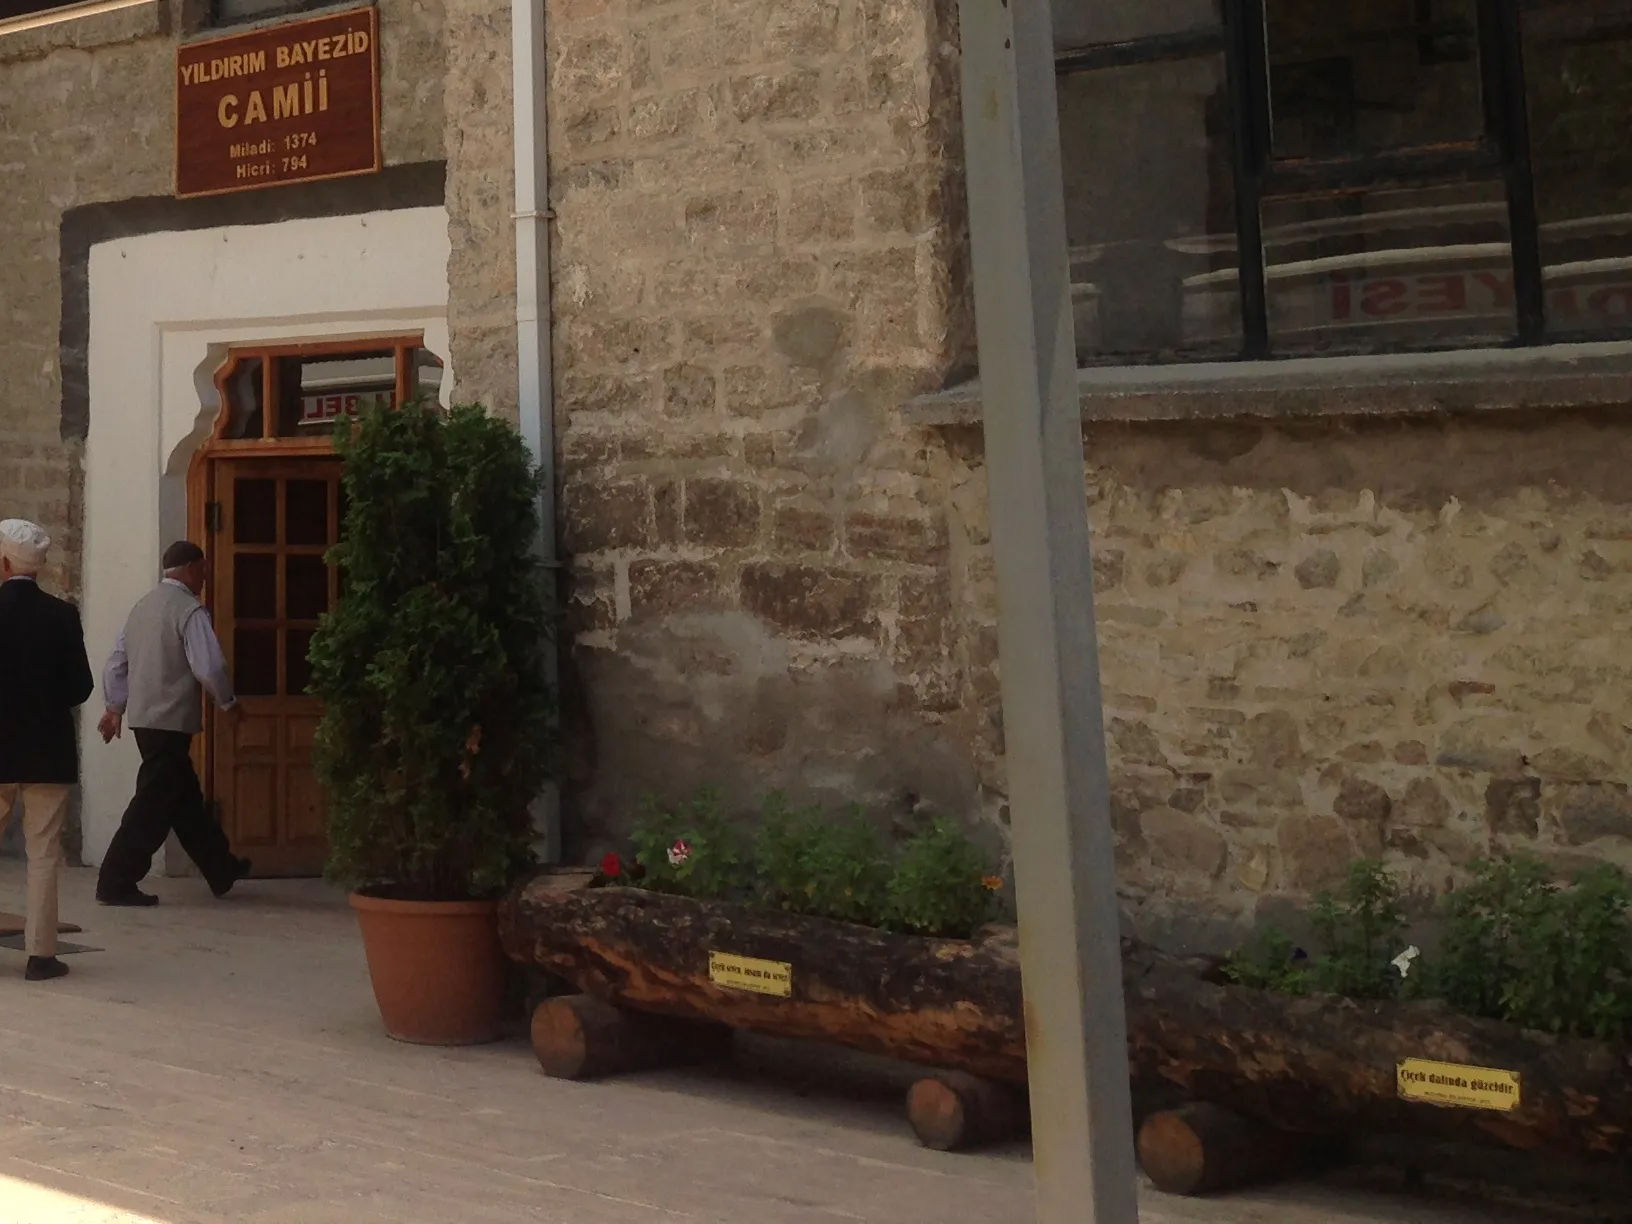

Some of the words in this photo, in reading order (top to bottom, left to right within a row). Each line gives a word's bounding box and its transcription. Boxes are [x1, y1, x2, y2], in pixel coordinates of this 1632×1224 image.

[180, 50, 266, 86] YILDIRIM
[276, 27, 369, 69] BAYEZİD
[218, 69, 329, 128] CAMİİ
[230, 139, 276, 158] Miladi:
[284, 131, 317, 150] 1374
[281, 154, 308, 172] 794
